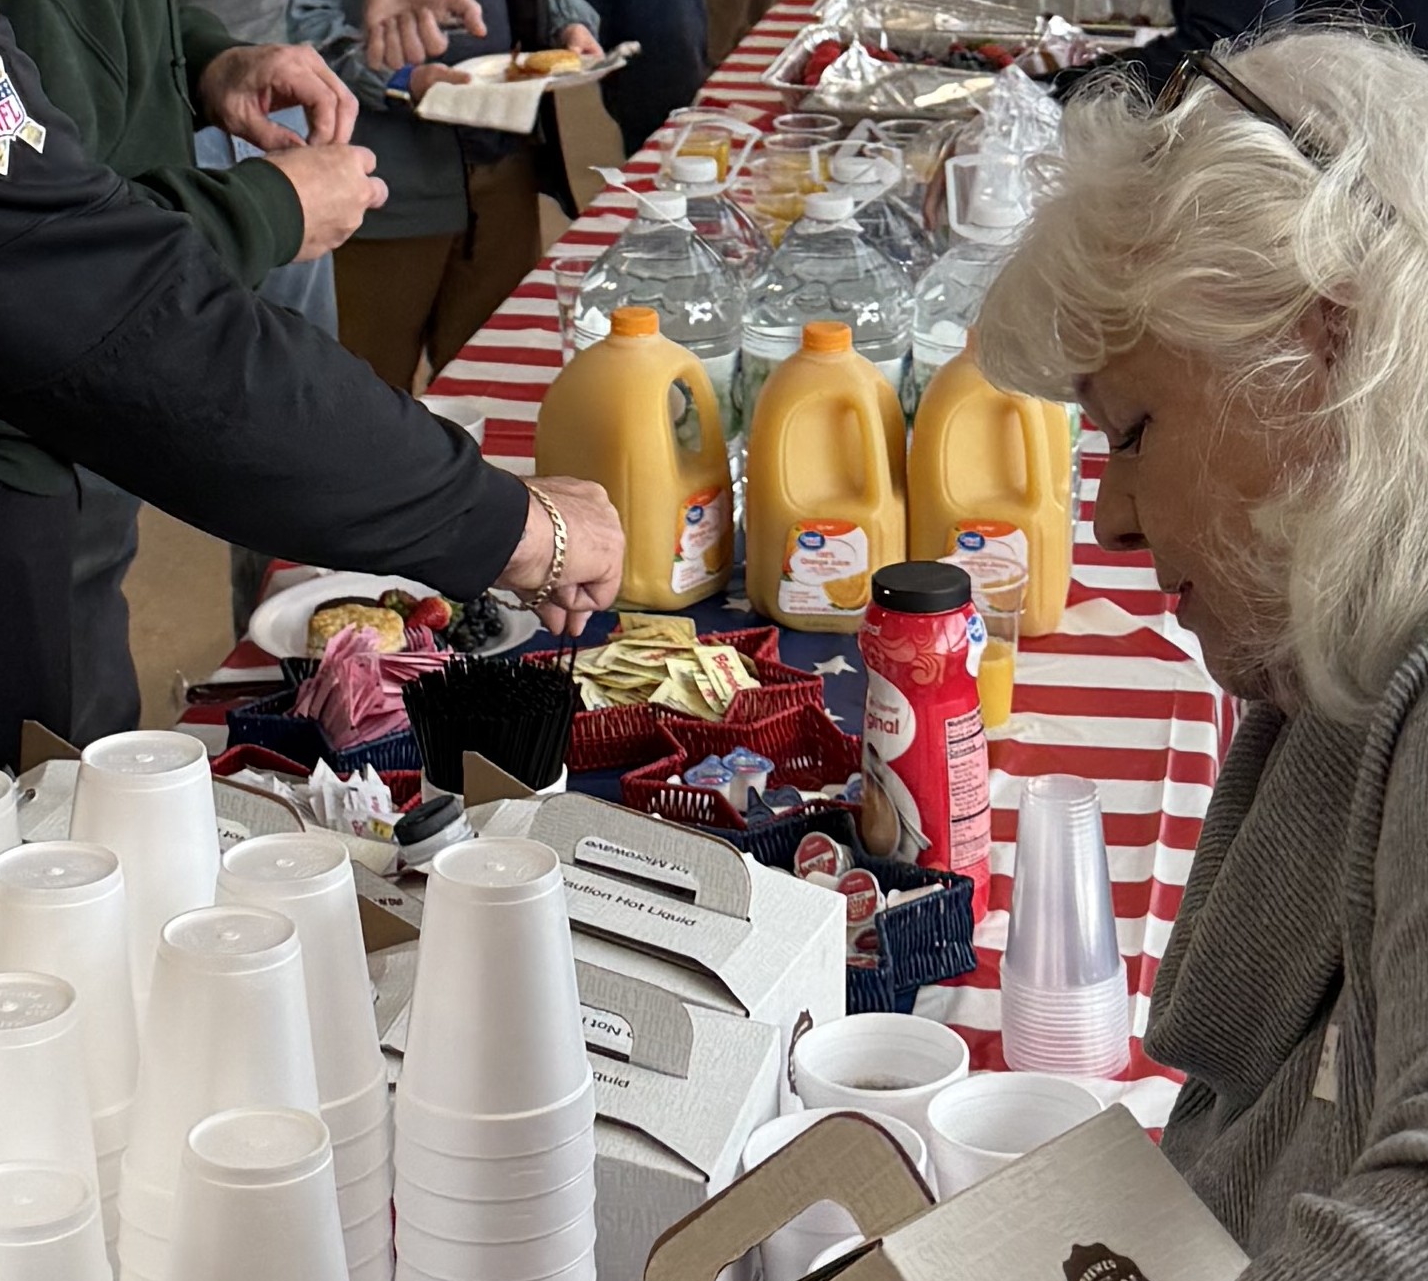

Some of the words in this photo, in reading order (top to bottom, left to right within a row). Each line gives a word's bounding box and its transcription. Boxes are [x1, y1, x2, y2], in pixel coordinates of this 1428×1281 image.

[584, 840, 668, 869] Microwave
[615, 895, 646, 912] Hot
[647, 905, 697, 927] Liquid
[590, 1018, 622, 1037] Not
[593, 1071, 631, 1089] quid
